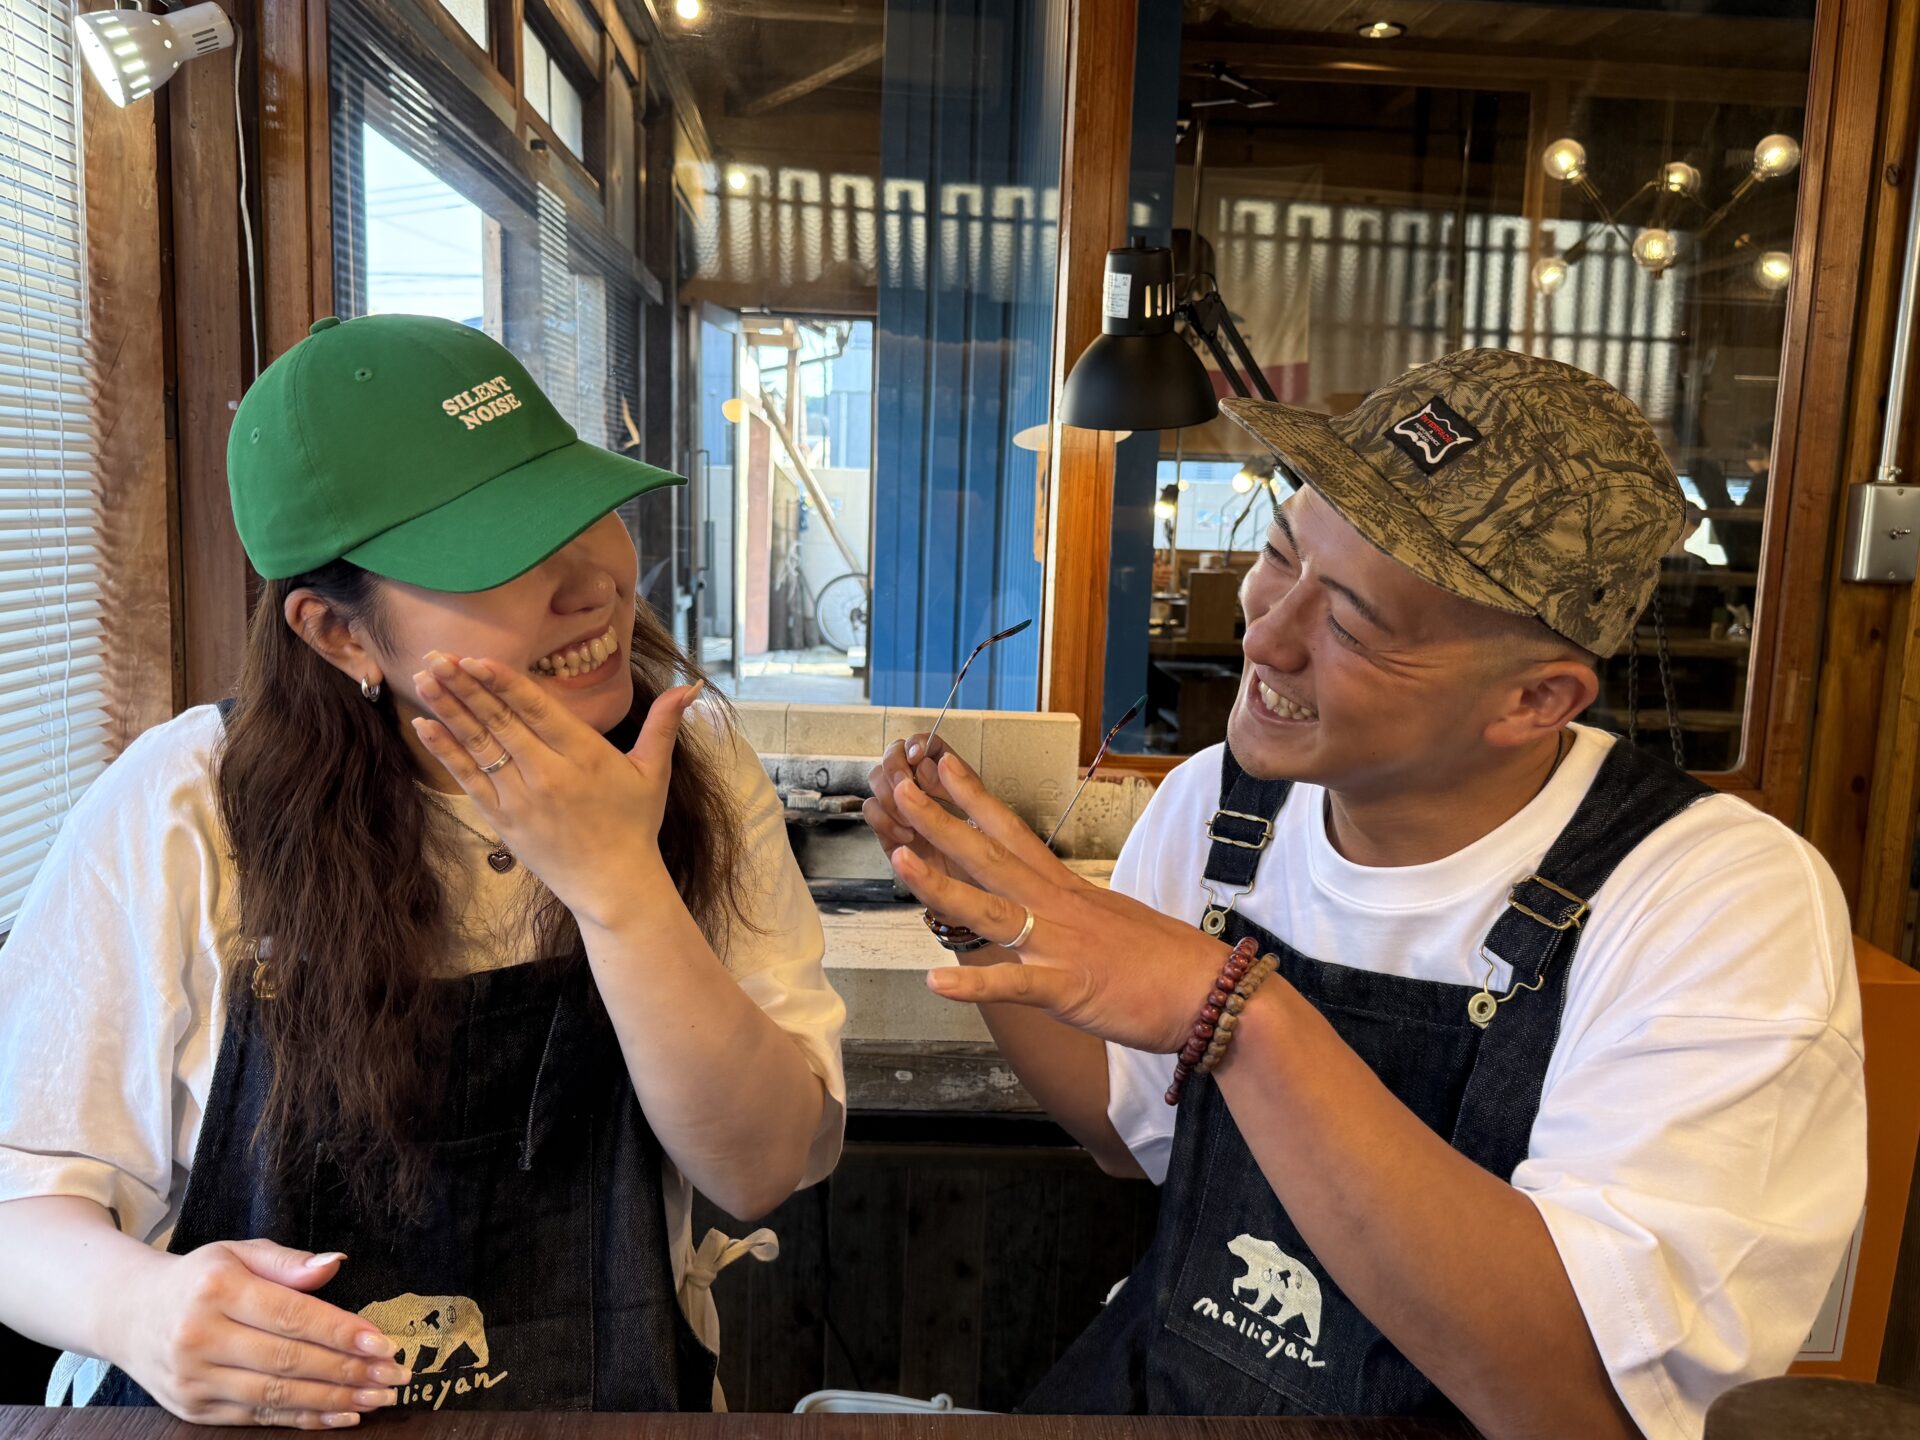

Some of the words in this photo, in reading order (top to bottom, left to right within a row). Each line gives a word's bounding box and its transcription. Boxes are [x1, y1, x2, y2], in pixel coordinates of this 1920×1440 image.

[442, 376, 511, 416] SILENT
[458, 393, 522, 430] NOISE
[1193, 1297, 1326, 1368] mallieyan
